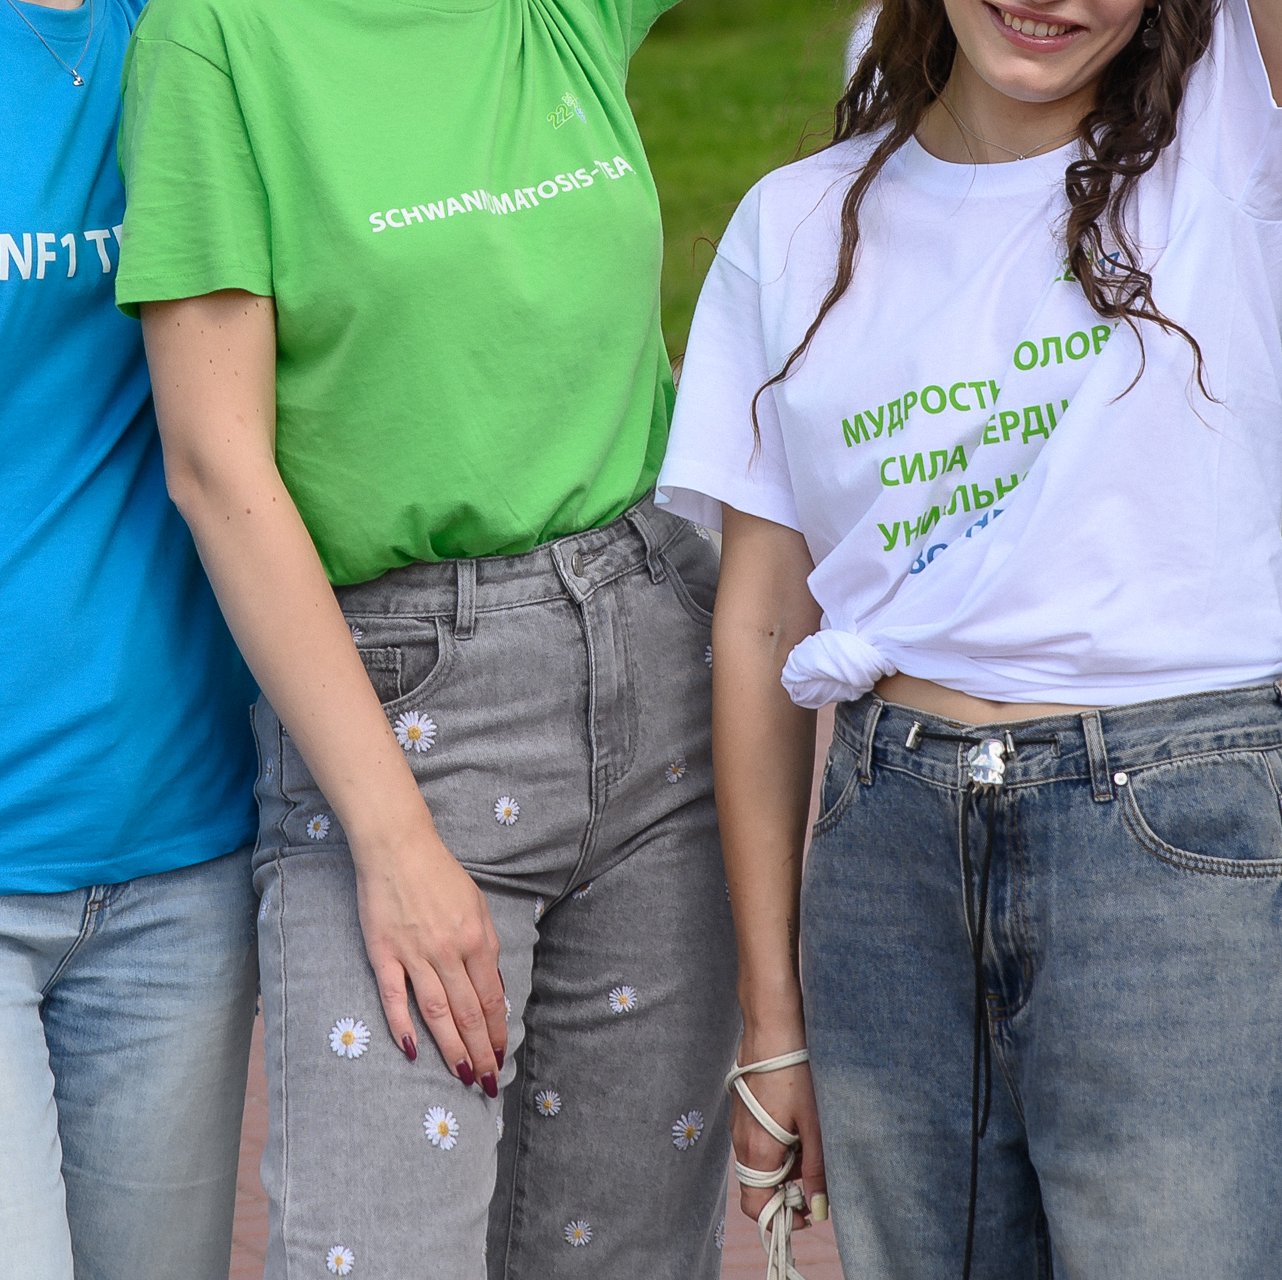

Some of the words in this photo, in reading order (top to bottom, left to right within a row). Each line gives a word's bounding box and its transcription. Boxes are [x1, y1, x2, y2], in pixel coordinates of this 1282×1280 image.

[547, 103, 574, 130] 22
[368, 155, 637, 233] SCHWANNOMATOSIS-TEA
[83, 223, 123, 274] T
[1013, 322, 1120, 371] ОЛОВ
[880, 445, 968, 487] СИЛА
[977, 399, 1069, 446] ЕРД
